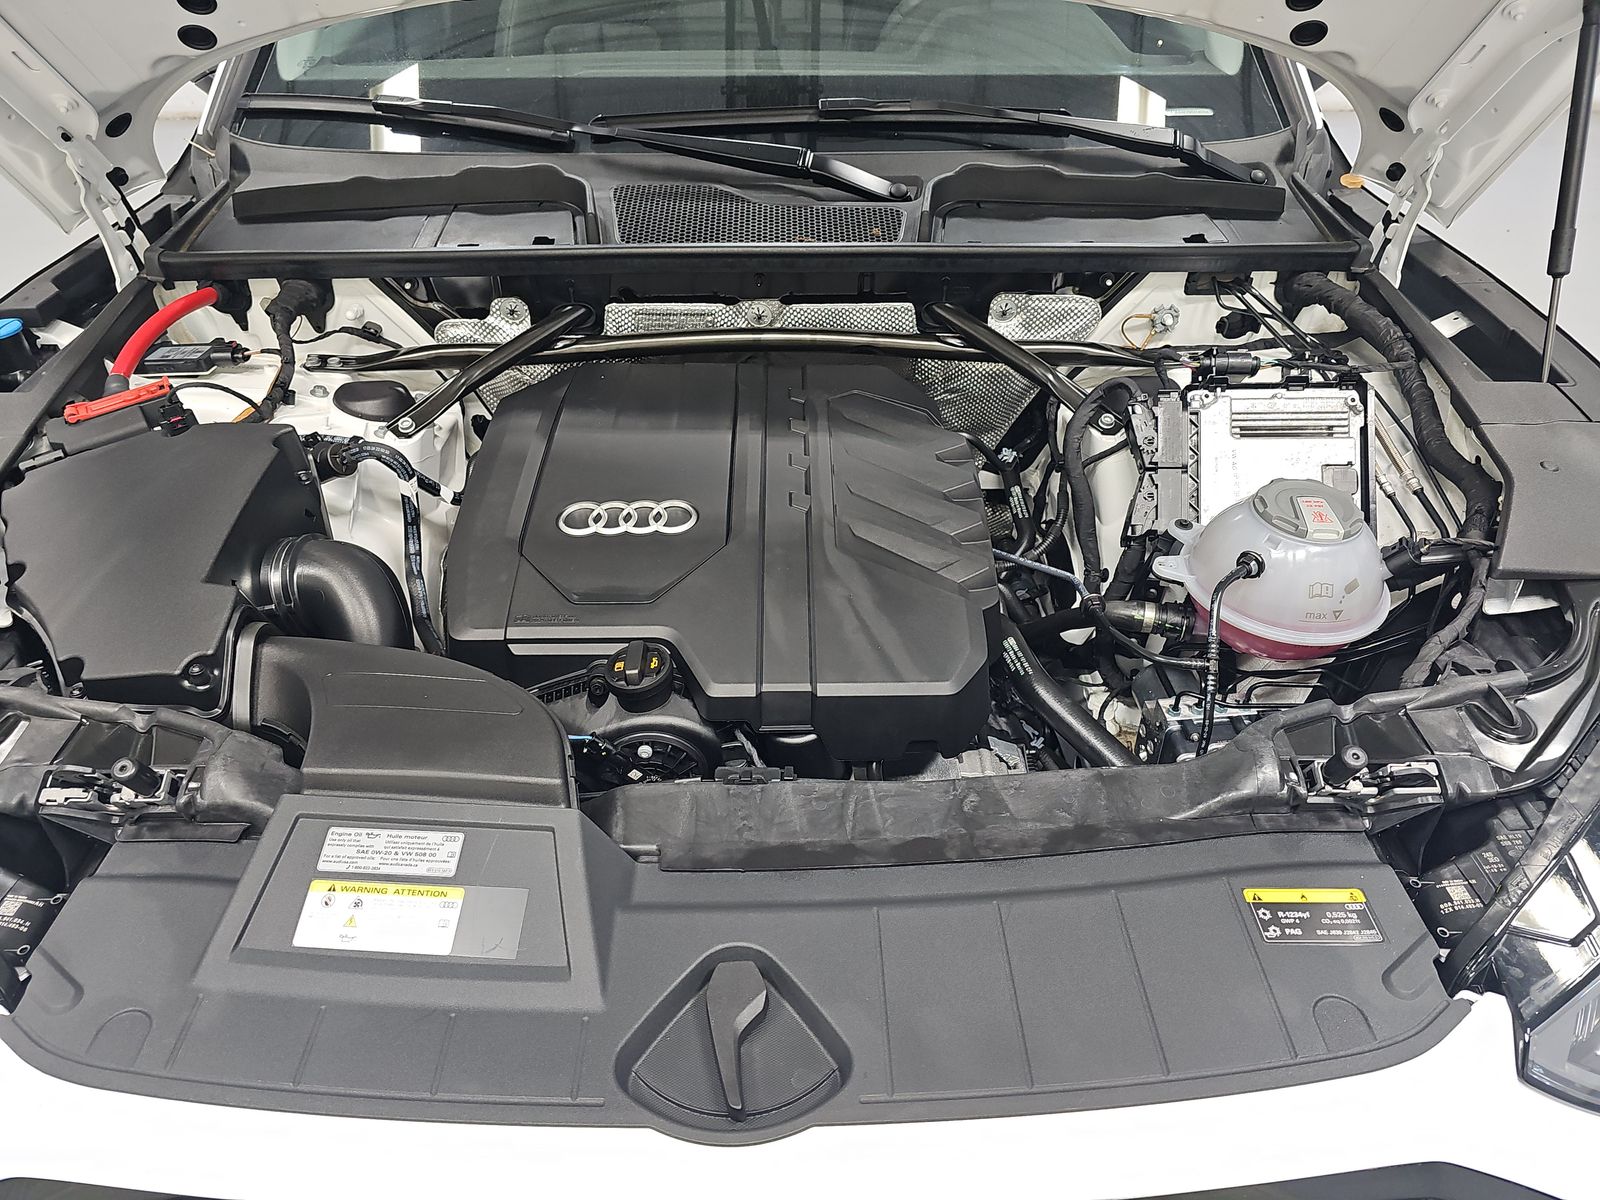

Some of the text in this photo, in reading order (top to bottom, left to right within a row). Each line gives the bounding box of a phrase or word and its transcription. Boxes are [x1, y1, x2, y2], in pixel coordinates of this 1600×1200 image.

[1305, 611, 1328, 620] max
[340, 885, 448, 898] WARNING ATTENTION
[1277, 911, 1358, 920] R-1234yf 0,525 kg
